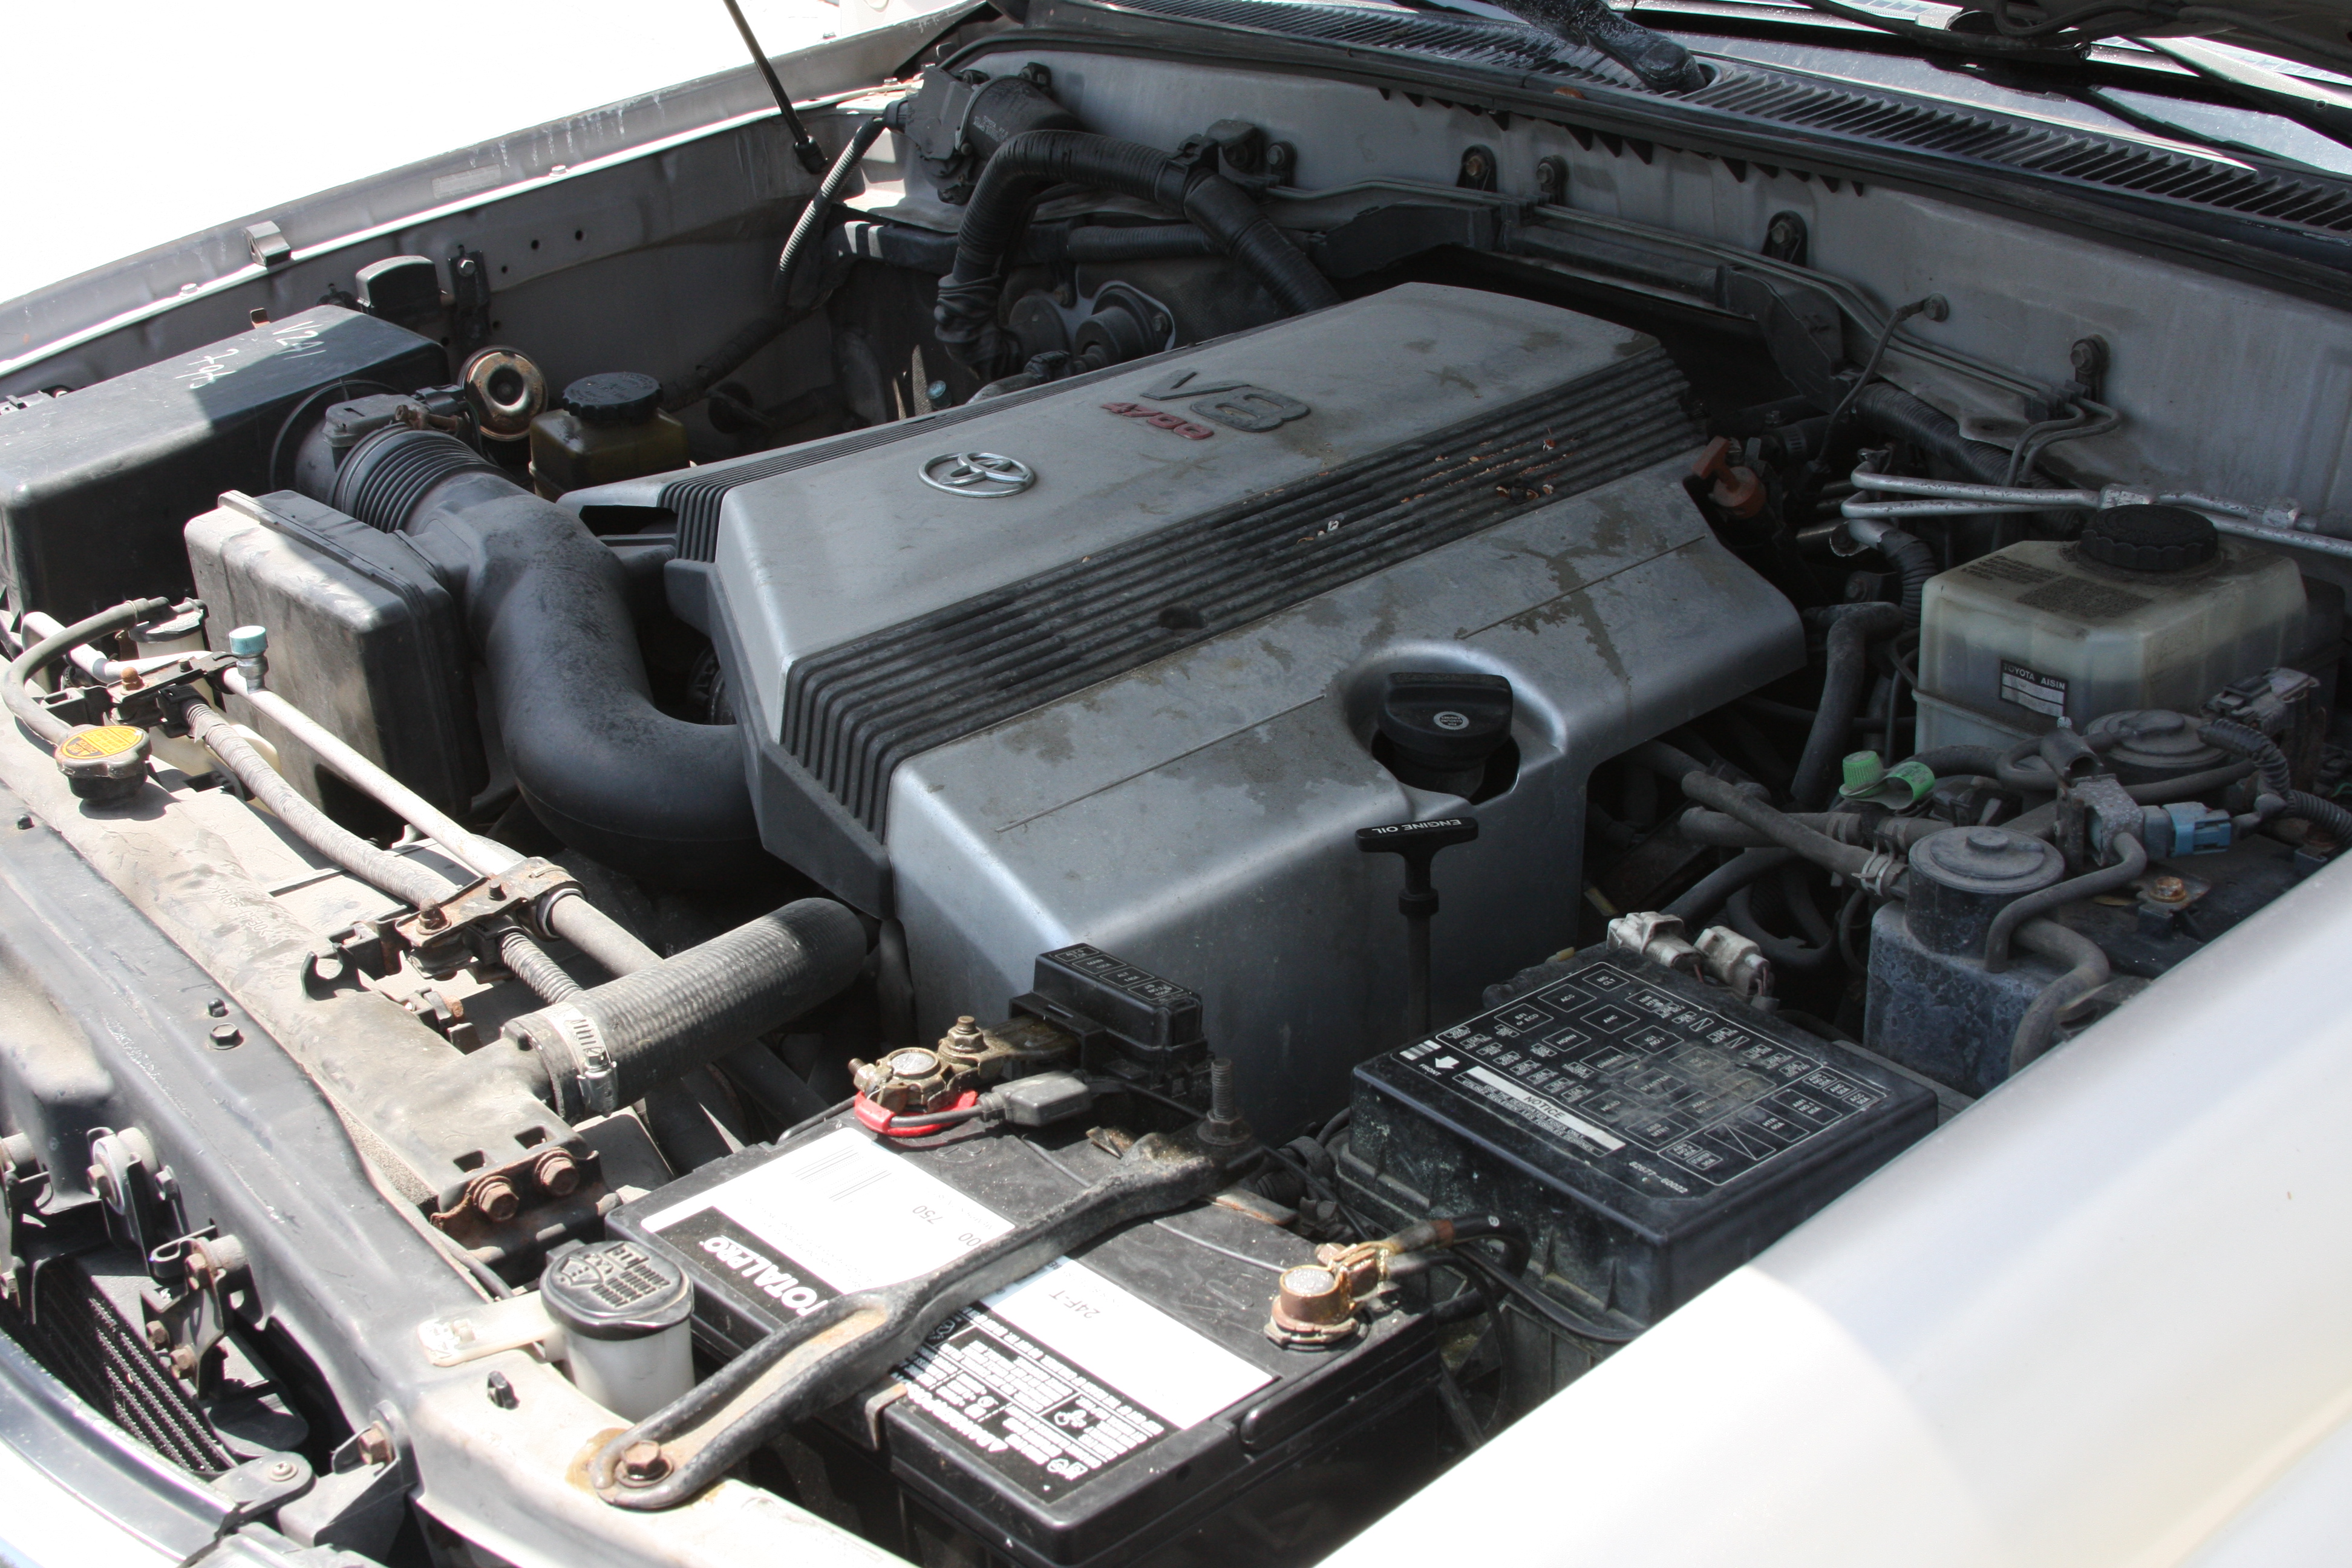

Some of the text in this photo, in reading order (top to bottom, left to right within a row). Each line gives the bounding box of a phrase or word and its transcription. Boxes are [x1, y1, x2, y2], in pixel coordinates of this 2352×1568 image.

[1140, 370, 1312, 433] V8
[1100, 402, 1215, 440] 4700
[2003, 663, 2065, 690] TOYOTA AISIN
[1402, 819, 1462, 831] ENGINE
[1560, 993, 1575, 1002] ACC
[1603, 1014, 1618, 1024] AHC
[1557, 1034, 1576, 1045] HORN
[1650, 1036, 1664, 1046] NO.1
[1417, 1063, 1441, 1077] FRONT
[1641, 1074, 1669, 1091] STARTER
[1850, 1093, 1863, 1102] ACC
[1484, 1084, 1497, 1093] USE
[1546, 1117, 1567, 1130] FUSES
[1524, 1096, 1564, 1119] NOTICE
[1601, 1099, 1620, 1111] HEAD
[1799, 1102, 1814, 1112] NO.1
[1520, 1109, 1535, 1119] LES
[1763, 1117, 1777, 1127] HTR
[1628, 1160, 1688, 1195] 82677-60022
[912, 1204, 944, 1224] 750
[958, 1232, 982, 1247] 00
[704, 1237, 828, 1317] TOTALPRO
[1048, 1290, 1100, 1319] 24F-T
